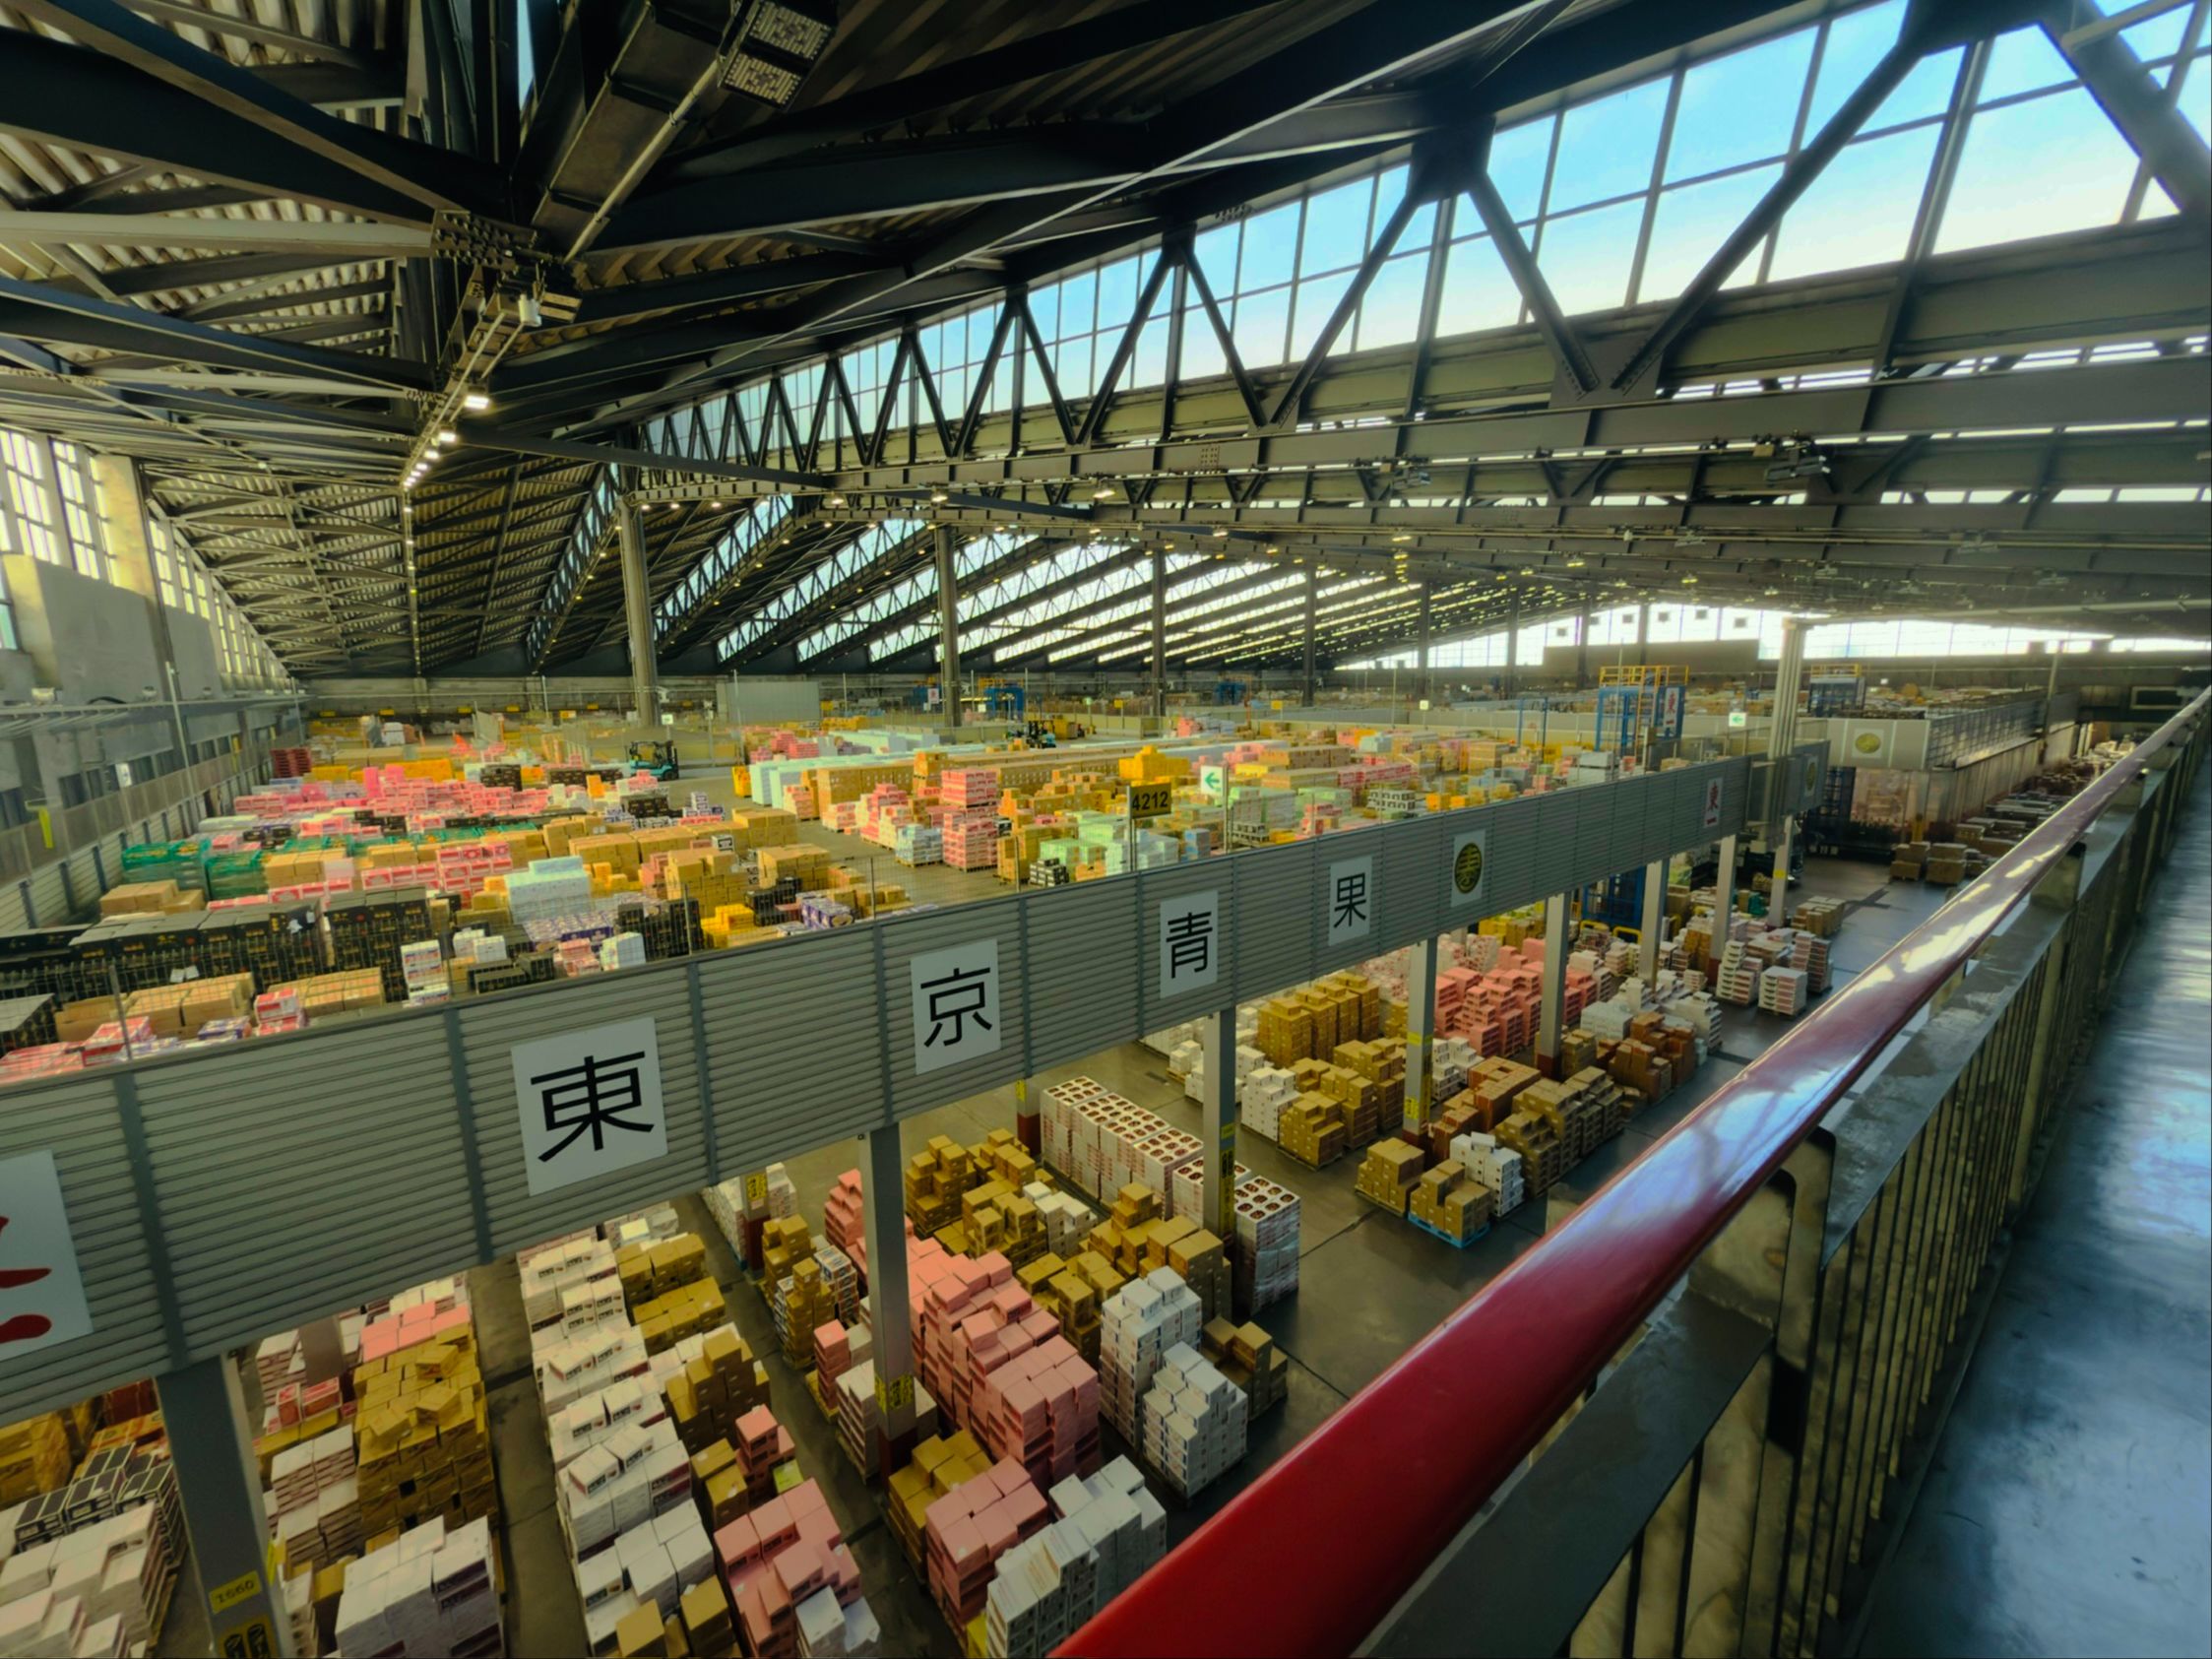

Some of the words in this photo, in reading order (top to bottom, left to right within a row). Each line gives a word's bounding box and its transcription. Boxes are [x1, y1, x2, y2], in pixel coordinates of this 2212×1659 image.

[1132, 791, 1169, 810] 4212
[530, 1051, 655, 1163] 東
[919, 967, 993, 1048] 京
[1166, 911, 1213, 980] 青
[1333, 872, 1367, 928] 果
